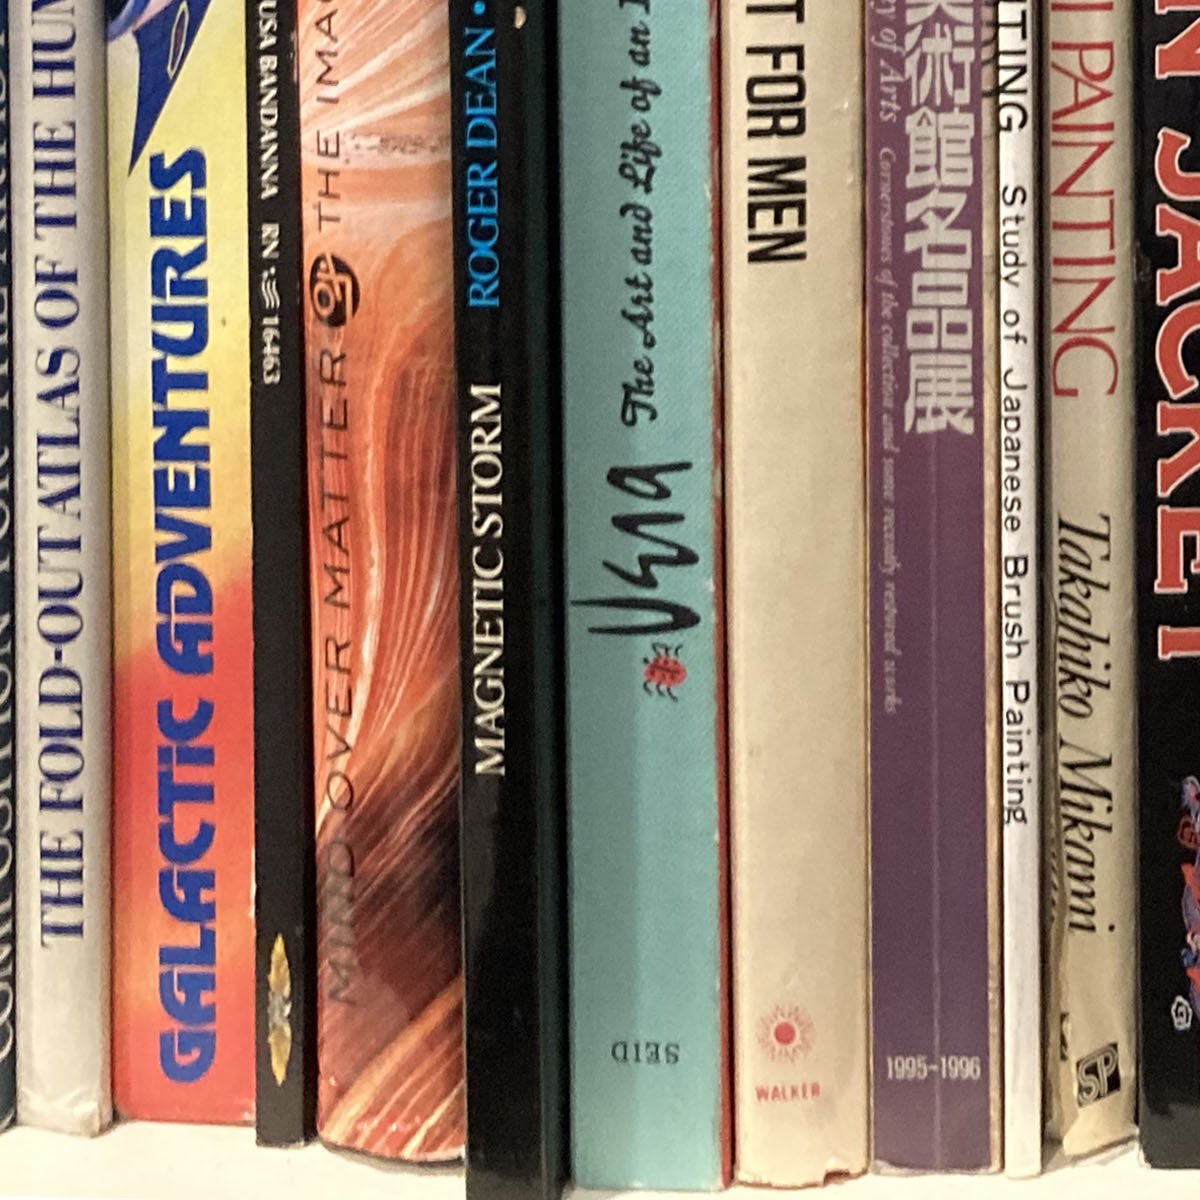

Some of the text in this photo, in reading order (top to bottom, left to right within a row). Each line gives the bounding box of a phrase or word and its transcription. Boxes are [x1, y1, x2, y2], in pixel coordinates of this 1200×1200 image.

[465, 28, 499, 155] DEAN
[632, 24, 652, 66] an
[746, 45, 807, 138] FOR
[874, 26, 903, 57] of
[878, 59, 900, 124] Arts
[620, 77, 662, 113] of
[34, 121, 78, 240] THE
[258, 0, 282, 384] USA BANDANNA RN 16463
[317, 129, 341, 233] THE
[620, 123, 662, 195] Life
[747, 157, 807, 265] MEN
[469, 162, 500, 308] ROGER
[620, 202, 653, 268] and
[1001, 184, 1028, 287] Study
[1050, 40, 1119, 398] PAINTING
[35, 255, 80, 330] OF
[620, 277, 655, 349] Art
[1003, 309, 1027, 342] of
[37, 348, 82, 526] ATLAS
[621, 353, 657, 427] The
[318, 347, 352, 615] MATTER
[1002, 368, 1028, 533] Japanese
[149, 147, 217, 1083] GALACTIC ADVENTURES
[470, 384, 506, 777] MAGNETIC STORM
[1003, 555, 1029, 660] Brush
[37, 527, 85, 815] FOLD-OUT
[326, 638, 355, 812] OVER
[1004, 680, 1031, 826] Painting
[1058, 513, 1116, 937] Takahiko Mikami
[40, 830, 85, 948] THE
[327, 840, 358, 1007] MIND
[611, 1040, 680, 1063] SEID
[756, 1082, 821, 1101] WALKER
[886, 1054, 981, 1081] 1995-1996
